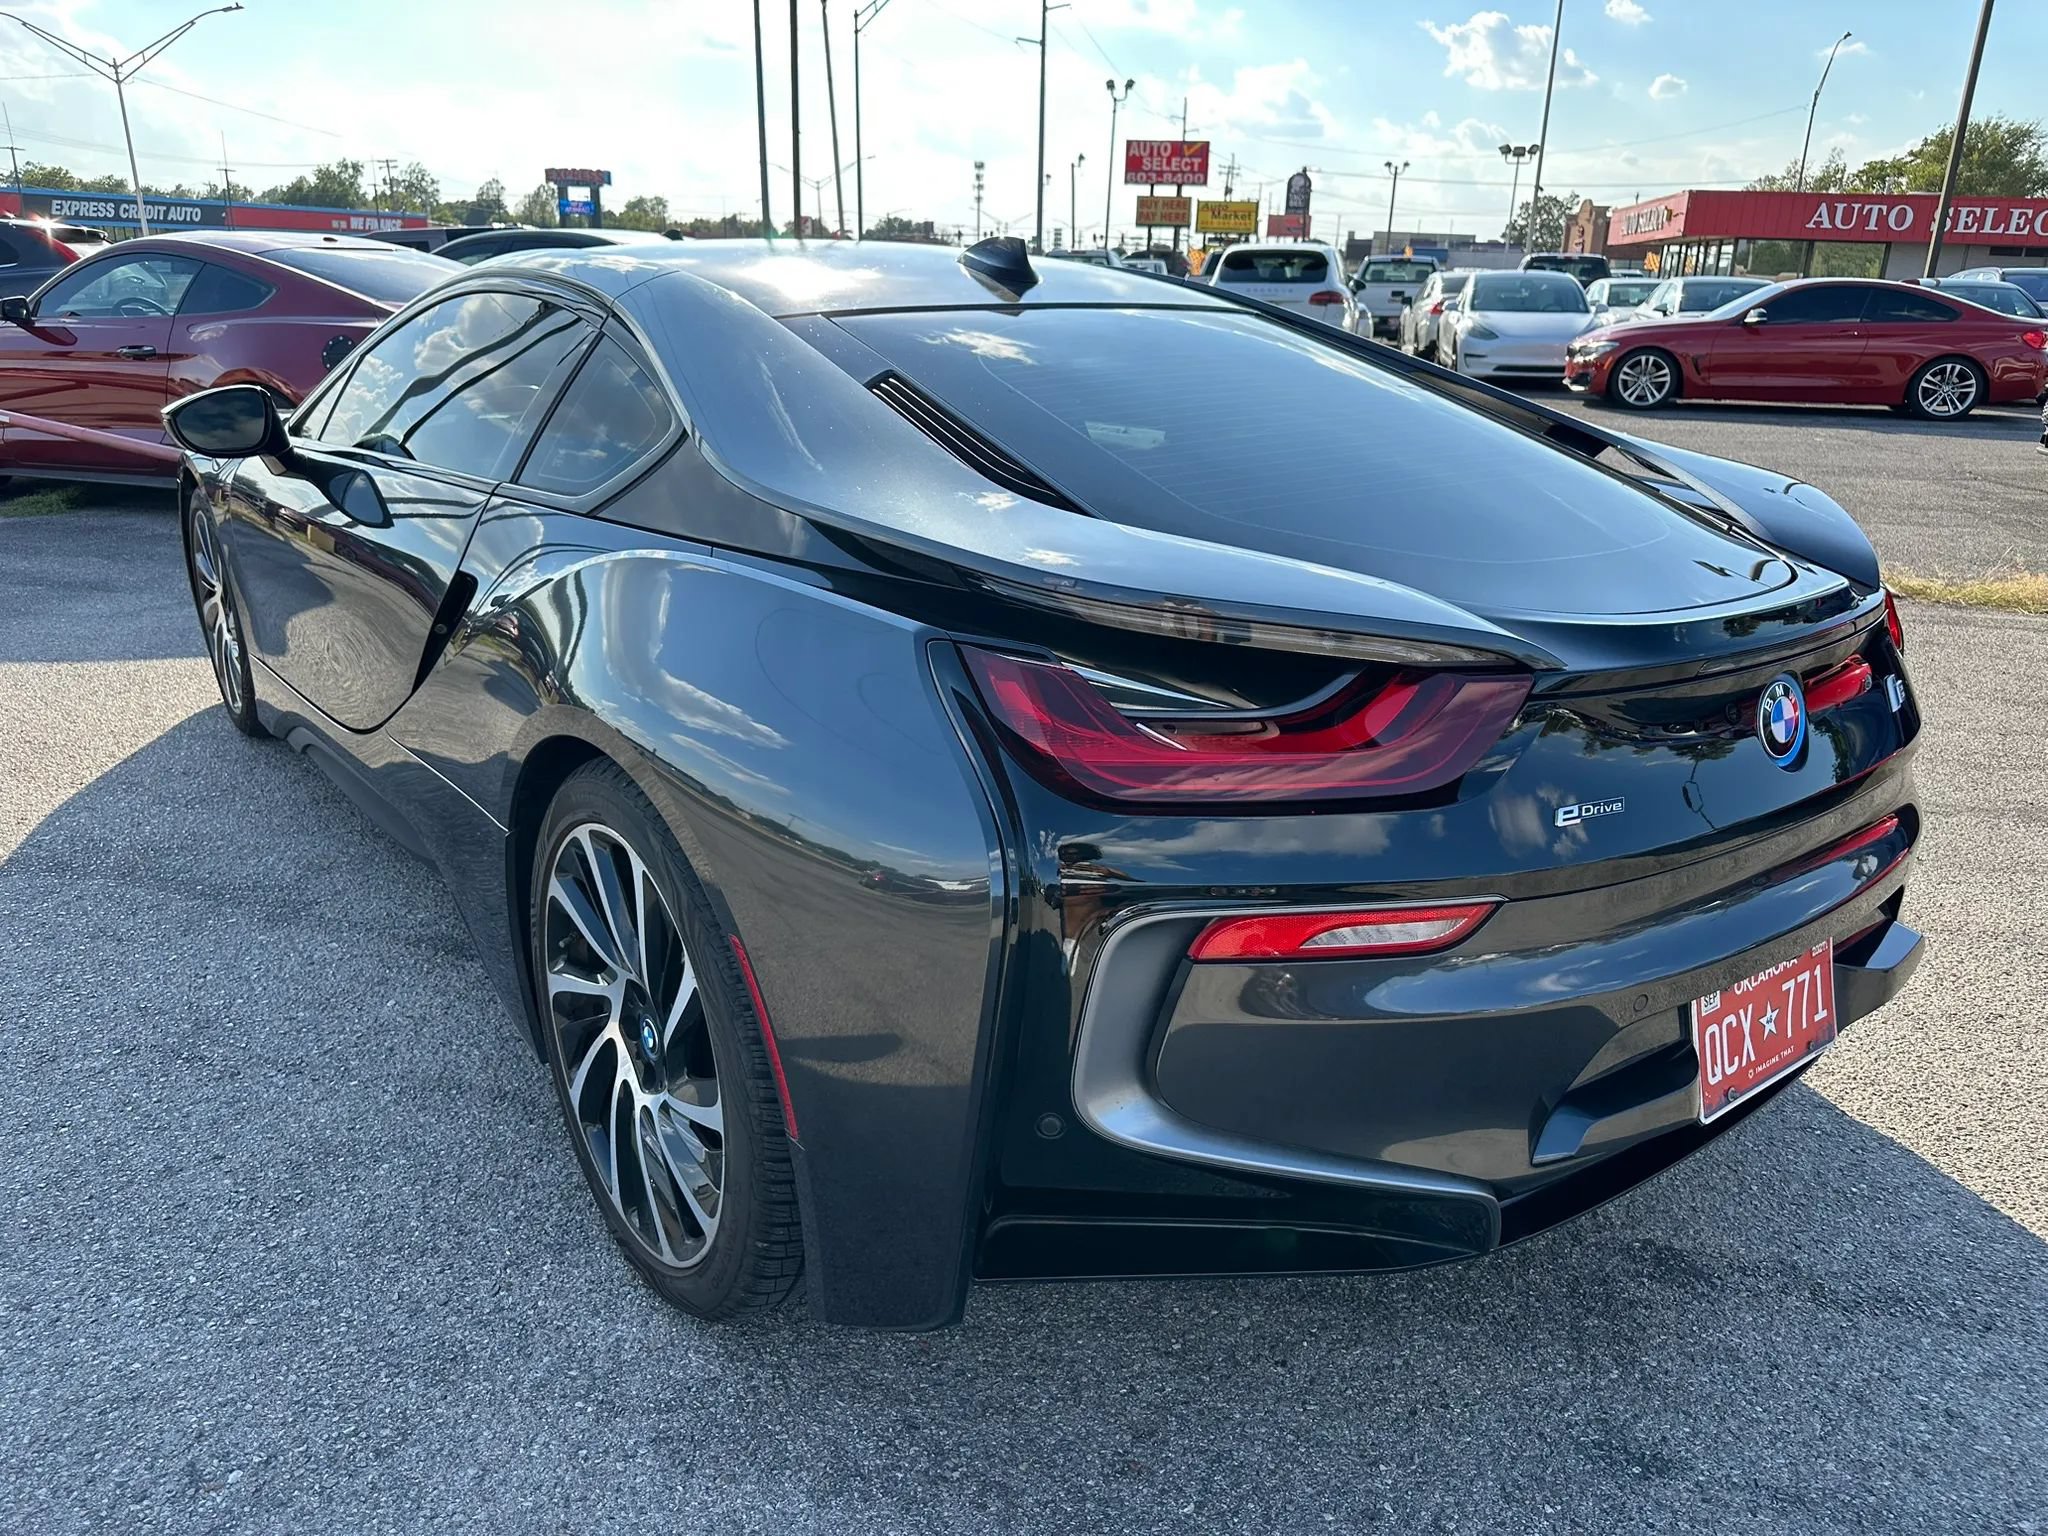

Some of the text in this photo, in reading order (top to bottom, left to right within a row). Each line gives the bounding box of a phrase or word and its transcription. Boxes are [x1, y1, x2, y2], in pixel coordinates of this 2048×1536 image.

[1128, 141, 1172, 157] AUTO
[1142, 157, 1203, 172] SELECT
[51, 200, 95, 218] EXPRESS
[167, 206, 202, 222] AUTO
[1162, 201, 1188, 210] HERE
[350, 216, 365, 230] WE
[1162, 212, 1187, 223] HERE
[1211, 210, 1252, 221] Market
[1806, 202, 1914, 231] AUTO
[1764, 684, 1796, 712] BMW
[1705, 964, 1828, 1085] QCX 771
[1755, 1045, 1795, 1074] IMAGINE THAT
